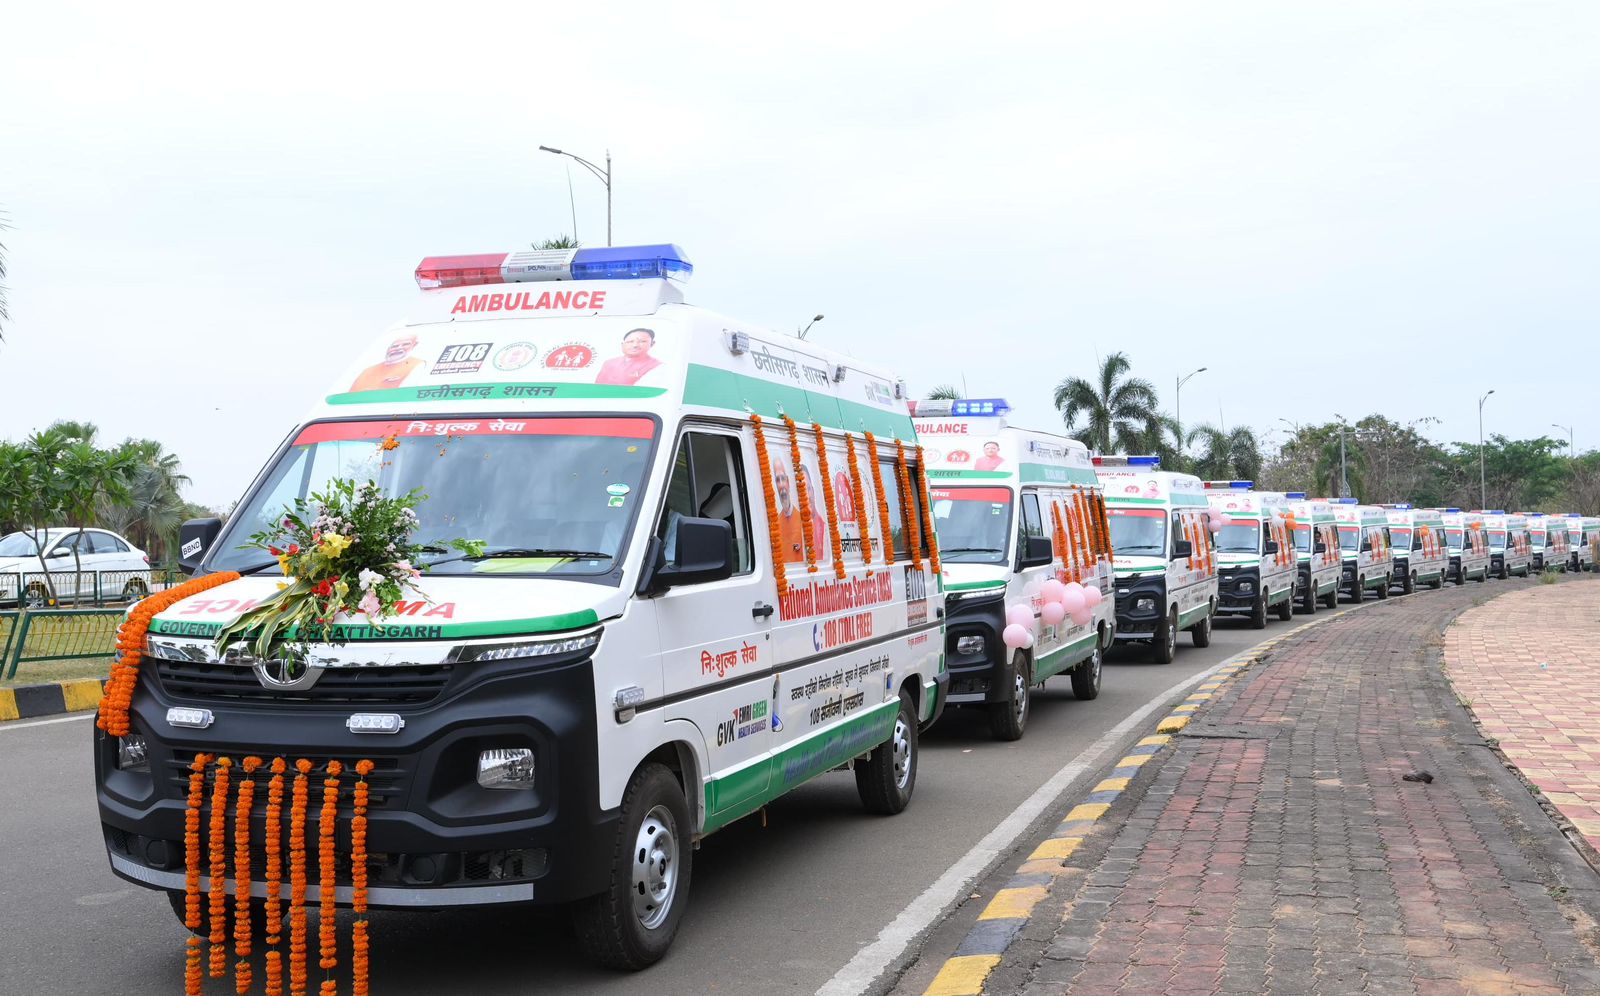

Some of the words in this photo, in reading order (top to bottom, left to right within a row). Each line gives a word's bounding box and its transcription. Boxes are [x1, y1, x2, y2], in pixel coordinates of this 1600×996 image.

[451, 291, 607, 314] AMBULANCE
[447, 344, 489, 362] 108
[802, 364, 830, 388] शासन
[503, 386, 557, 397] शासन
[488, 419, 526, 432] सेवा
[914, 423, 969, 434] BULANCE
[778, 582, 814, 621] National
[814, 579, 854, 615] Ambulance
[853, 575, 877, 607] Service
[295, 625, 442, 638] CHATTISGARH
[824, 619, 837, 648] 108
[741, 641, 757, 664] सेवा
[739, 704, 752, 724] EMRI
[752, 699, 767, 720] GREEN
[810, 707, 820, 726] 108
[717, 719, 736, 747] GVK
